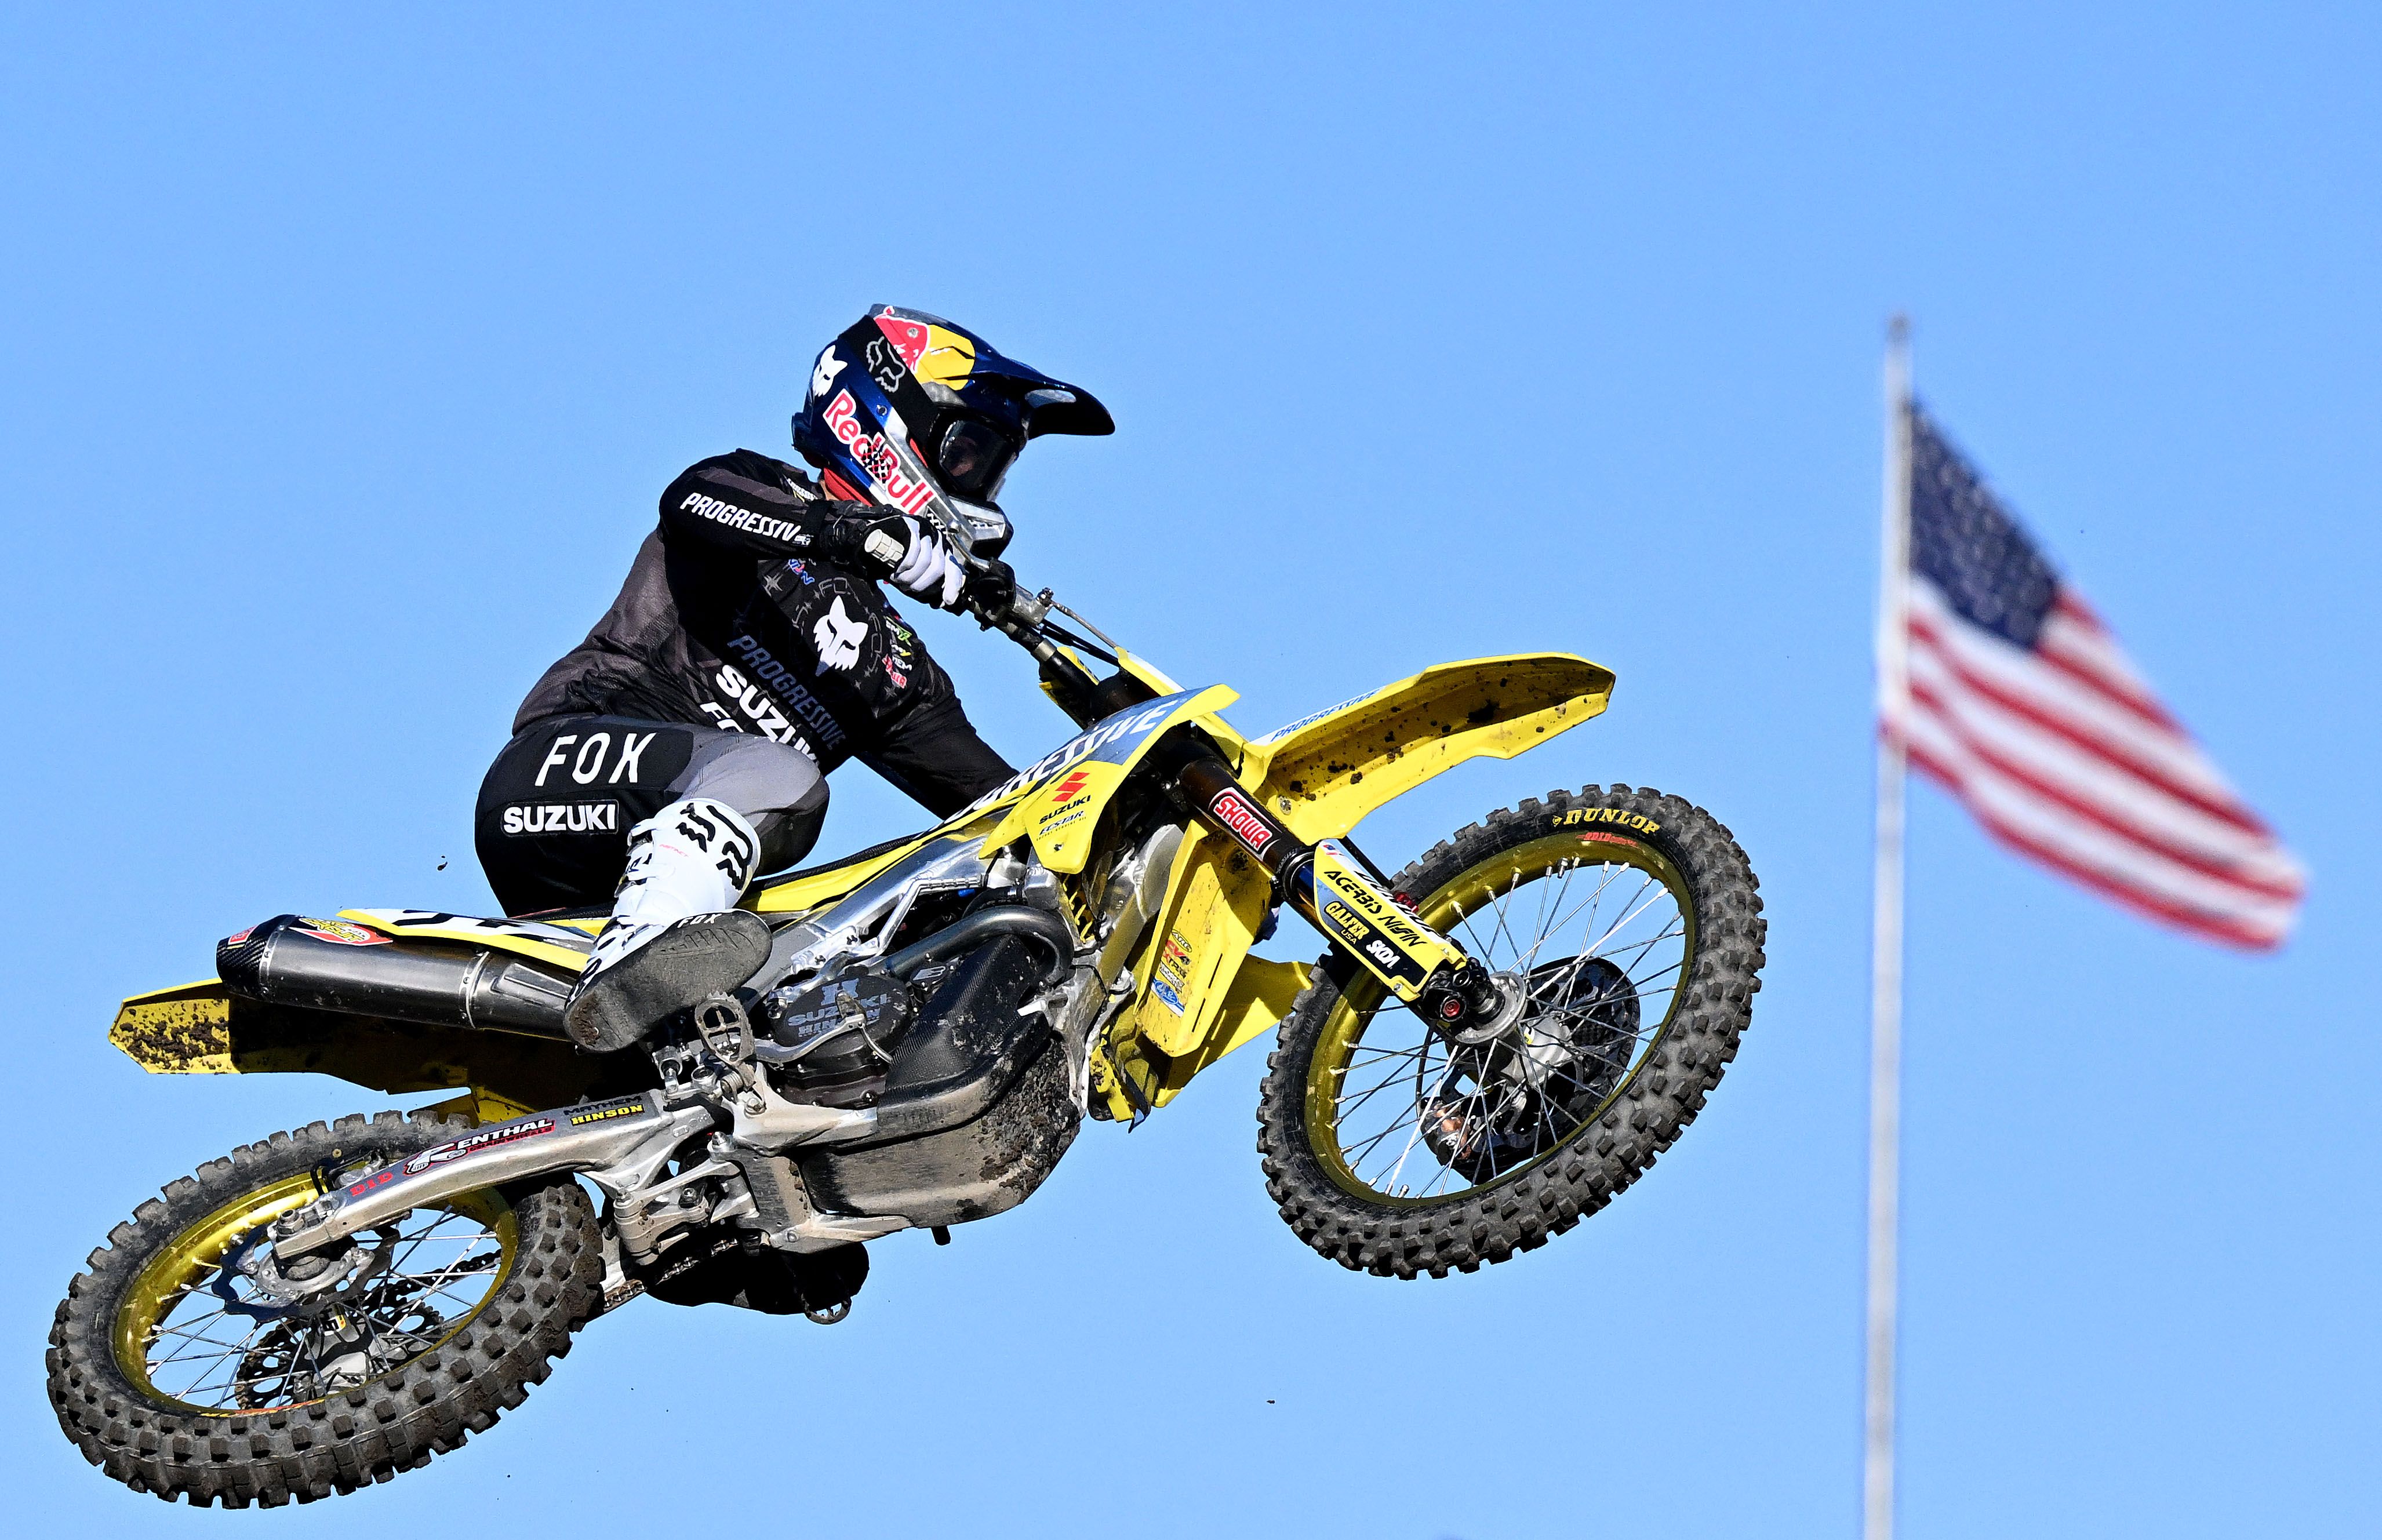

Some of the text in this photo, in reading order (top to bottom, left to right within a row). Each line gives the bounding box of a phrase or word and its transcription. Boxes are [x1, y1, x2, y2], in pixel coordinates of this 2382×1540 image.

[824, 391, 934, 515] Red Bull
[727, 635, 846, 751] PROGRESSIVE
[1270, 689, 1381, 742] PROGRESSIVE
[534, 732, 657, 787] FOX
[503, 803, 616, 834] SUZUKI
[1039, 795, 1091, 825] SUZUKI
[1213, 796, 1272, 849] SHOWA
[1563, 808, 1660, 835] DUNLOP
[677, 913, 722, 929] FOX
[1324, 901, 1401, 969] GALFER SKDA
[1377, 916, 1428, 947] NISSIN
[1172, 932, 1192, 952] ARC
[1340, 930, 1357, 945] USA
[788, 993, 888, 1026] SUZKI
[563, 1095, 642, 1116] MAYHEM
[570, 1104, 644, 1126] HINSON
[350, 1172, 394, 1197] DID
